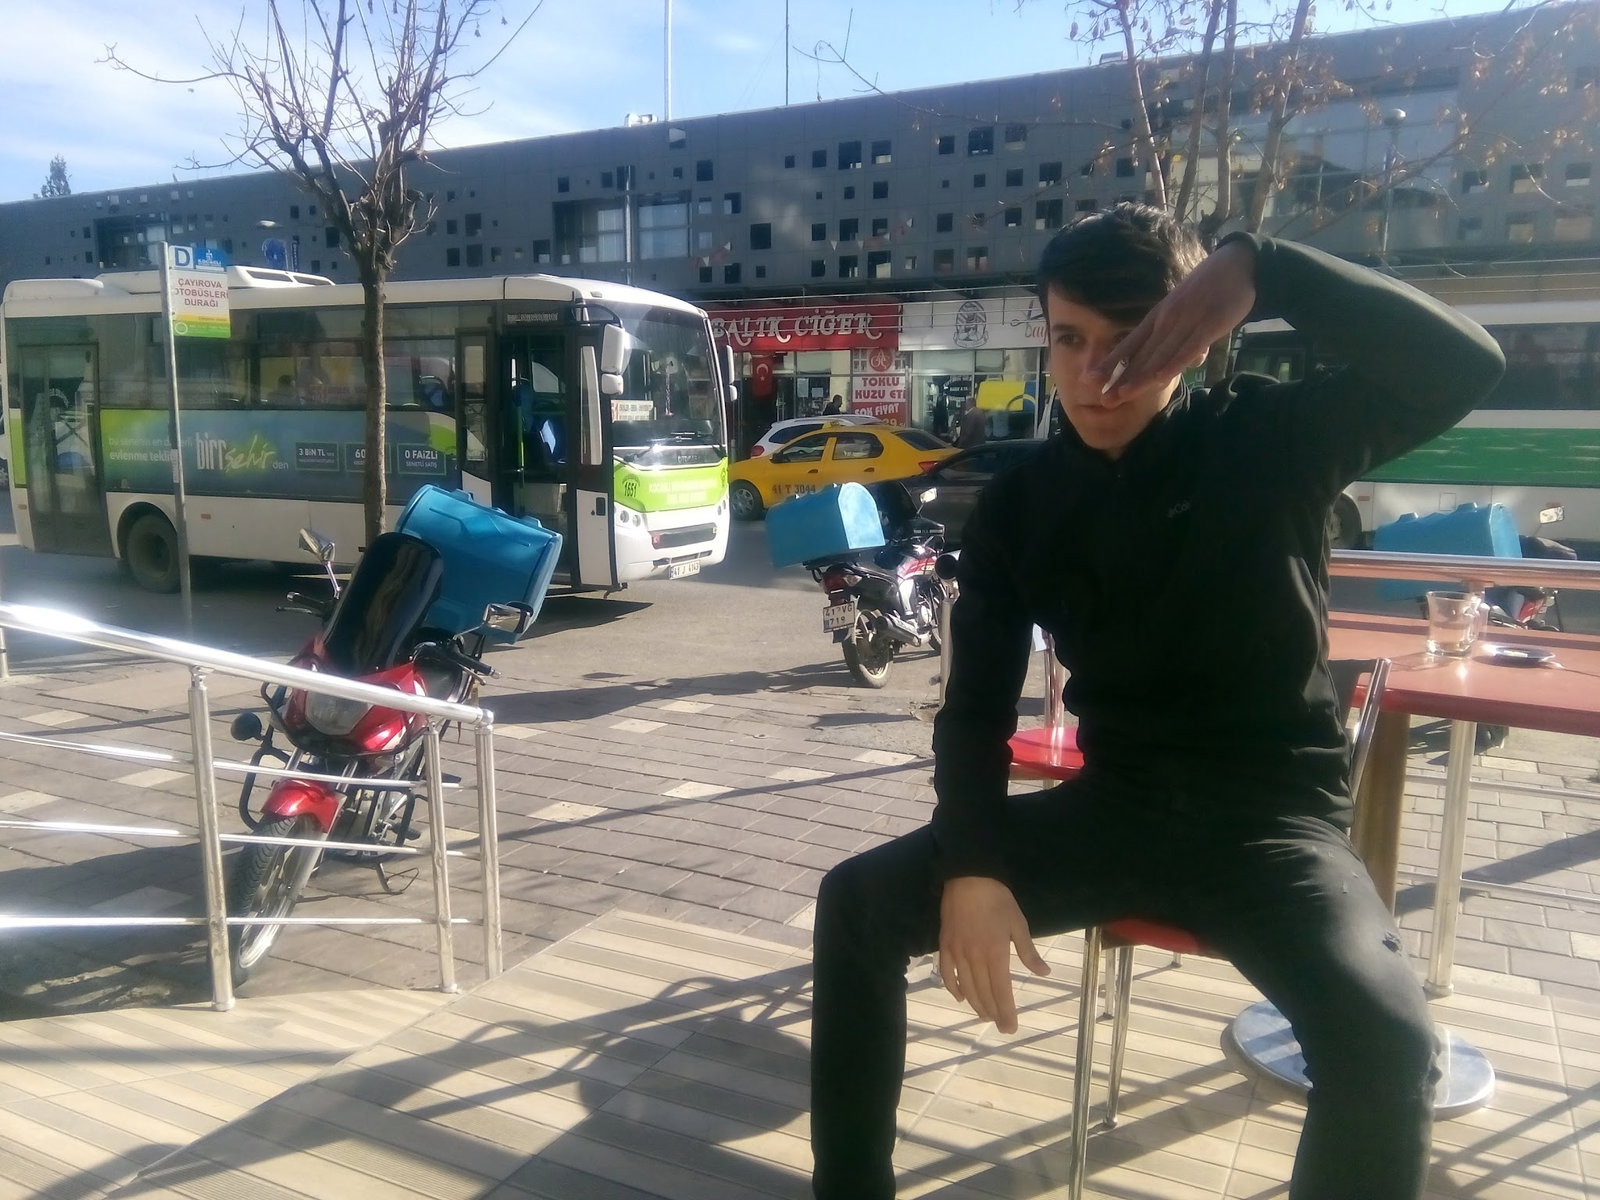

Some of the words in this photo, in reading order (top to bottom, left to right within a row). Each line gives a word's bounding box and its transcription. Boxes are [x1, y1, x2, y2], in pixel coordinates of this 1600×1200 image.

[174, 247, 191, 267] D
[178, 278, 222, 289] ÇAYIROVA
[711, 316, 791, 347] BALIK
[862, 376, 899, 387] TOKLU
[855, 389, 885, 399] KUZU
[317, 448, 326, 457] TL
[772, 484, 782, 495] 41
[785, 484, 791, 494] T
